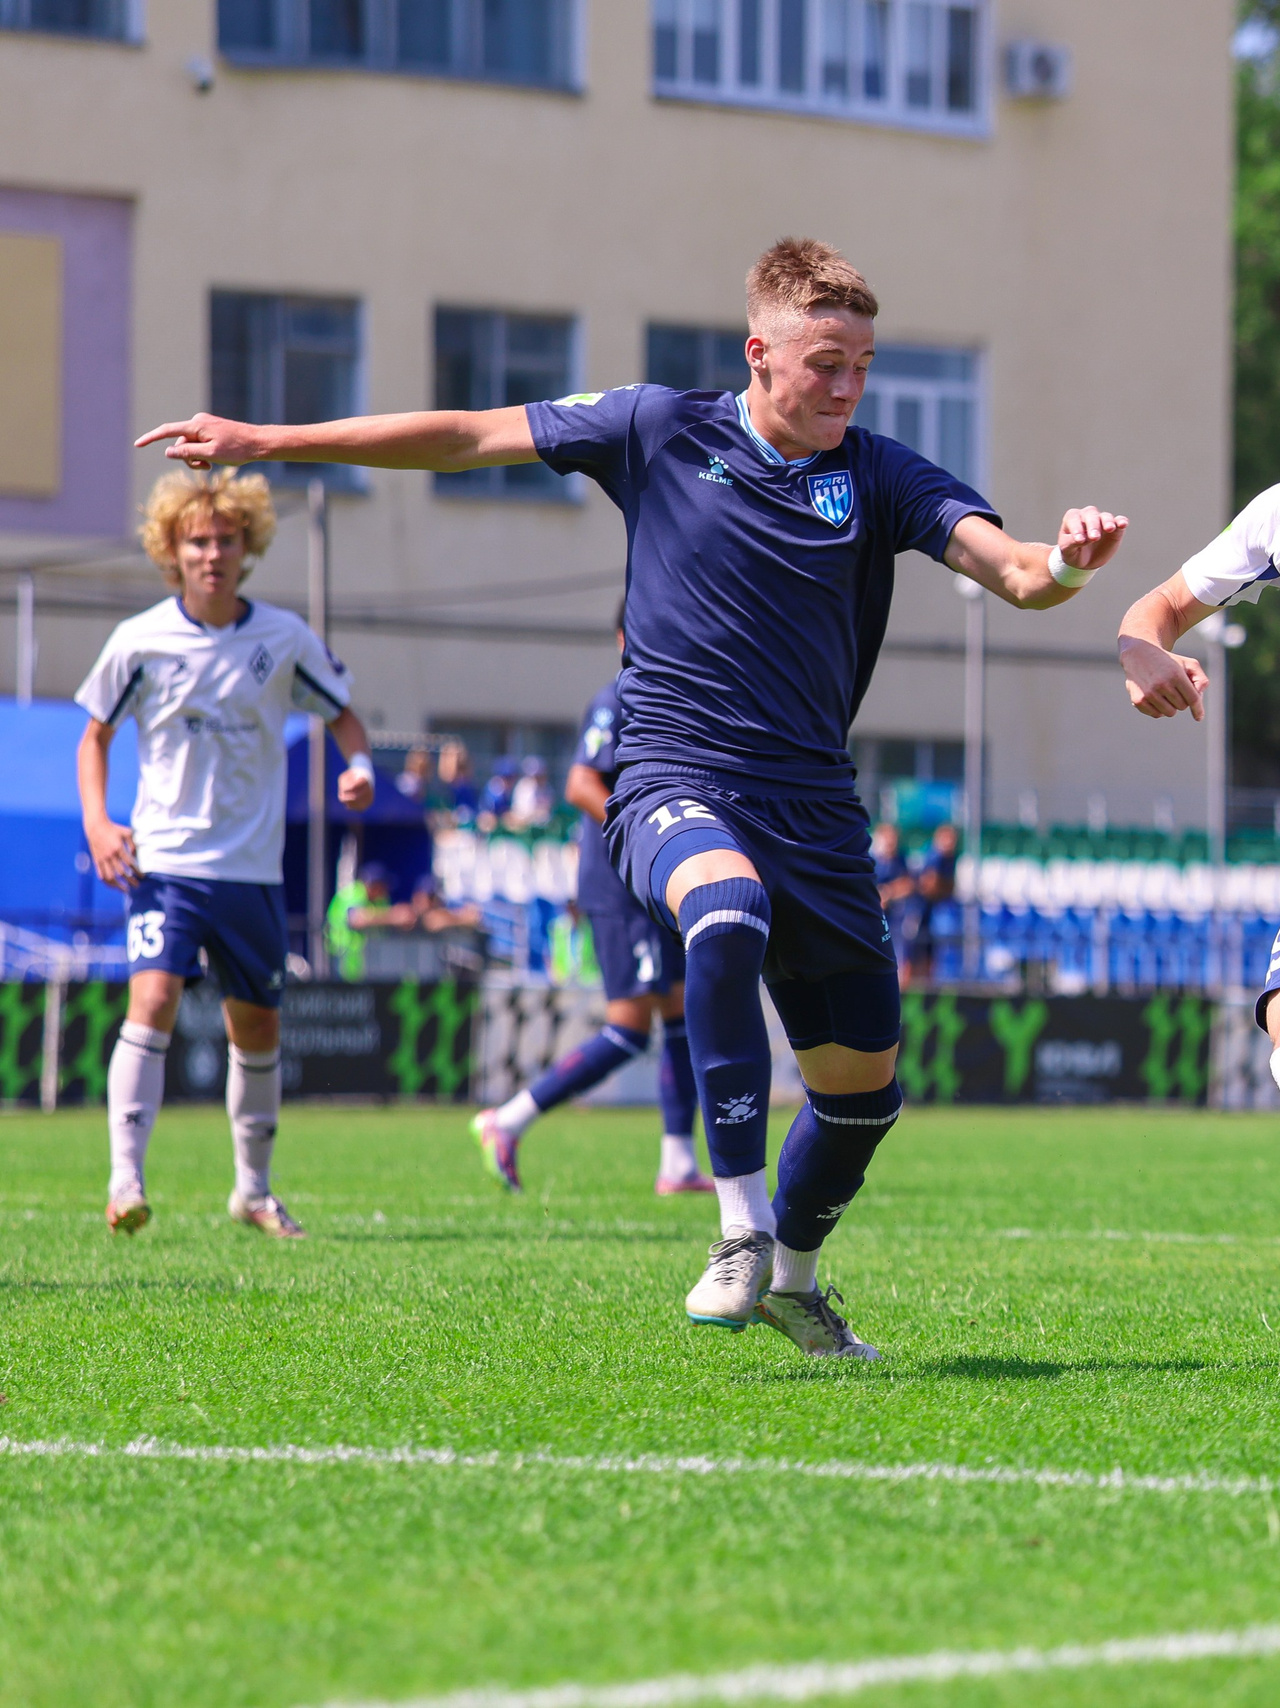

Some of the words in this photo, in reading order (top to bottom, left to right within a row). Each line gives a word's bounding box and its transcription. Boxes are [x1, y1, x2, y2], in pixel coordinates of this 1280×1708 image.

[698, 471, 734, 487] KELME
[647, 800, 718, 836] 12
[127, 910, 166, 963] 63
[715, 1107, 759, 1125] KELME
